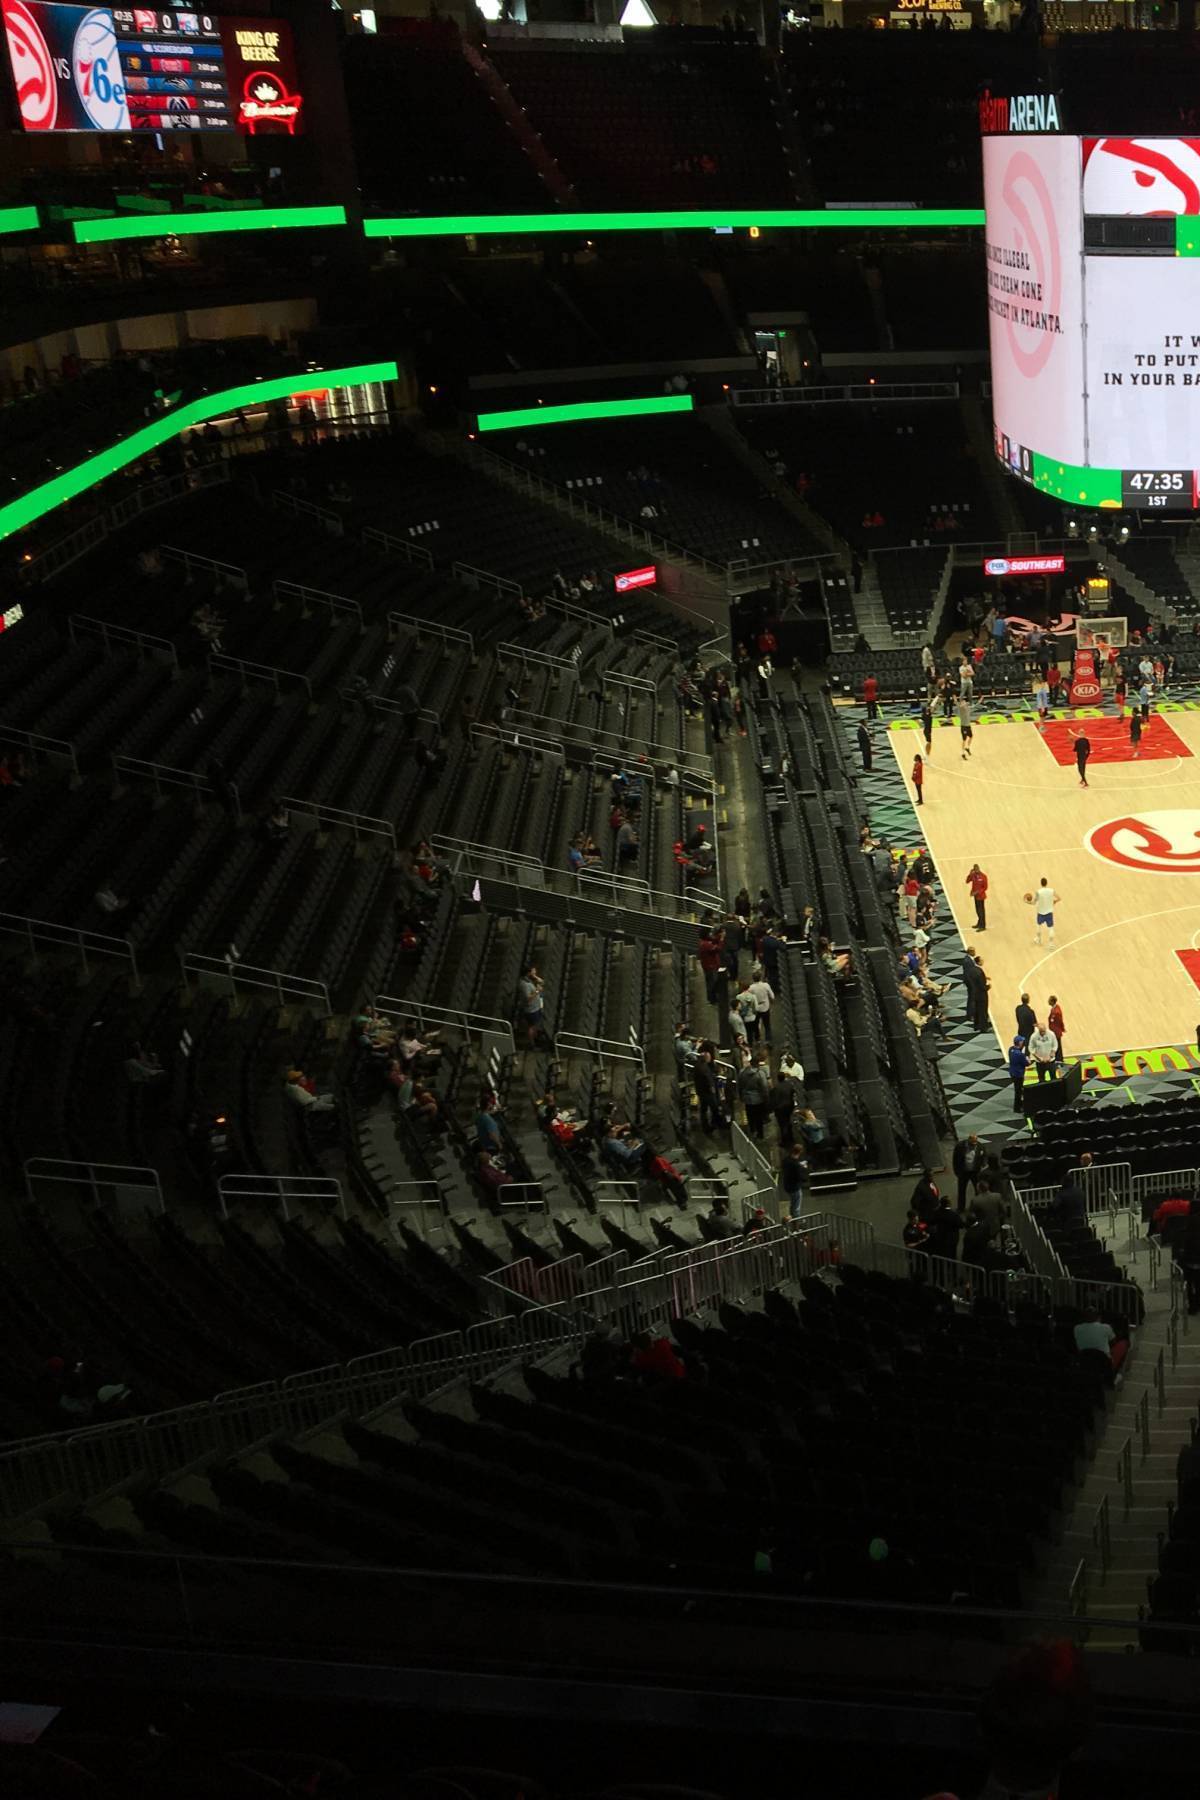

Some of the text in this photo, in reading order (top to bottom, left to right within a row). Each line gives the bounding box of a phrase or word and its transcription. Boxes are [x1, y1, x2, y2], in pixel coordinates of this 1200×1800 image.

[162, 15, 172, 29] 0
[203, 16, 212, 30] 0
[235, 31, 280, 47] KING OF
[53, 57, 71, 80] VS
[1009, 94, 1060, 131] ARENA
[1021, 280, 1042, 302] CONE
[1165, 335, 1183, 347] IT
[1134, 354, 1156, 366] TO
[1164, 354, 1198, 366] PUT
[1104, 372, 1123, 385] IN
[1130, 373, 1175, 385] YOUR
[1130, 473, 1184, 490] 47:35
[1147, 495, 1168, 506] 1ST
[1010, 559, 1064, 571] SOUTHEAST
[1077, 686, 1095, 694] KIA
